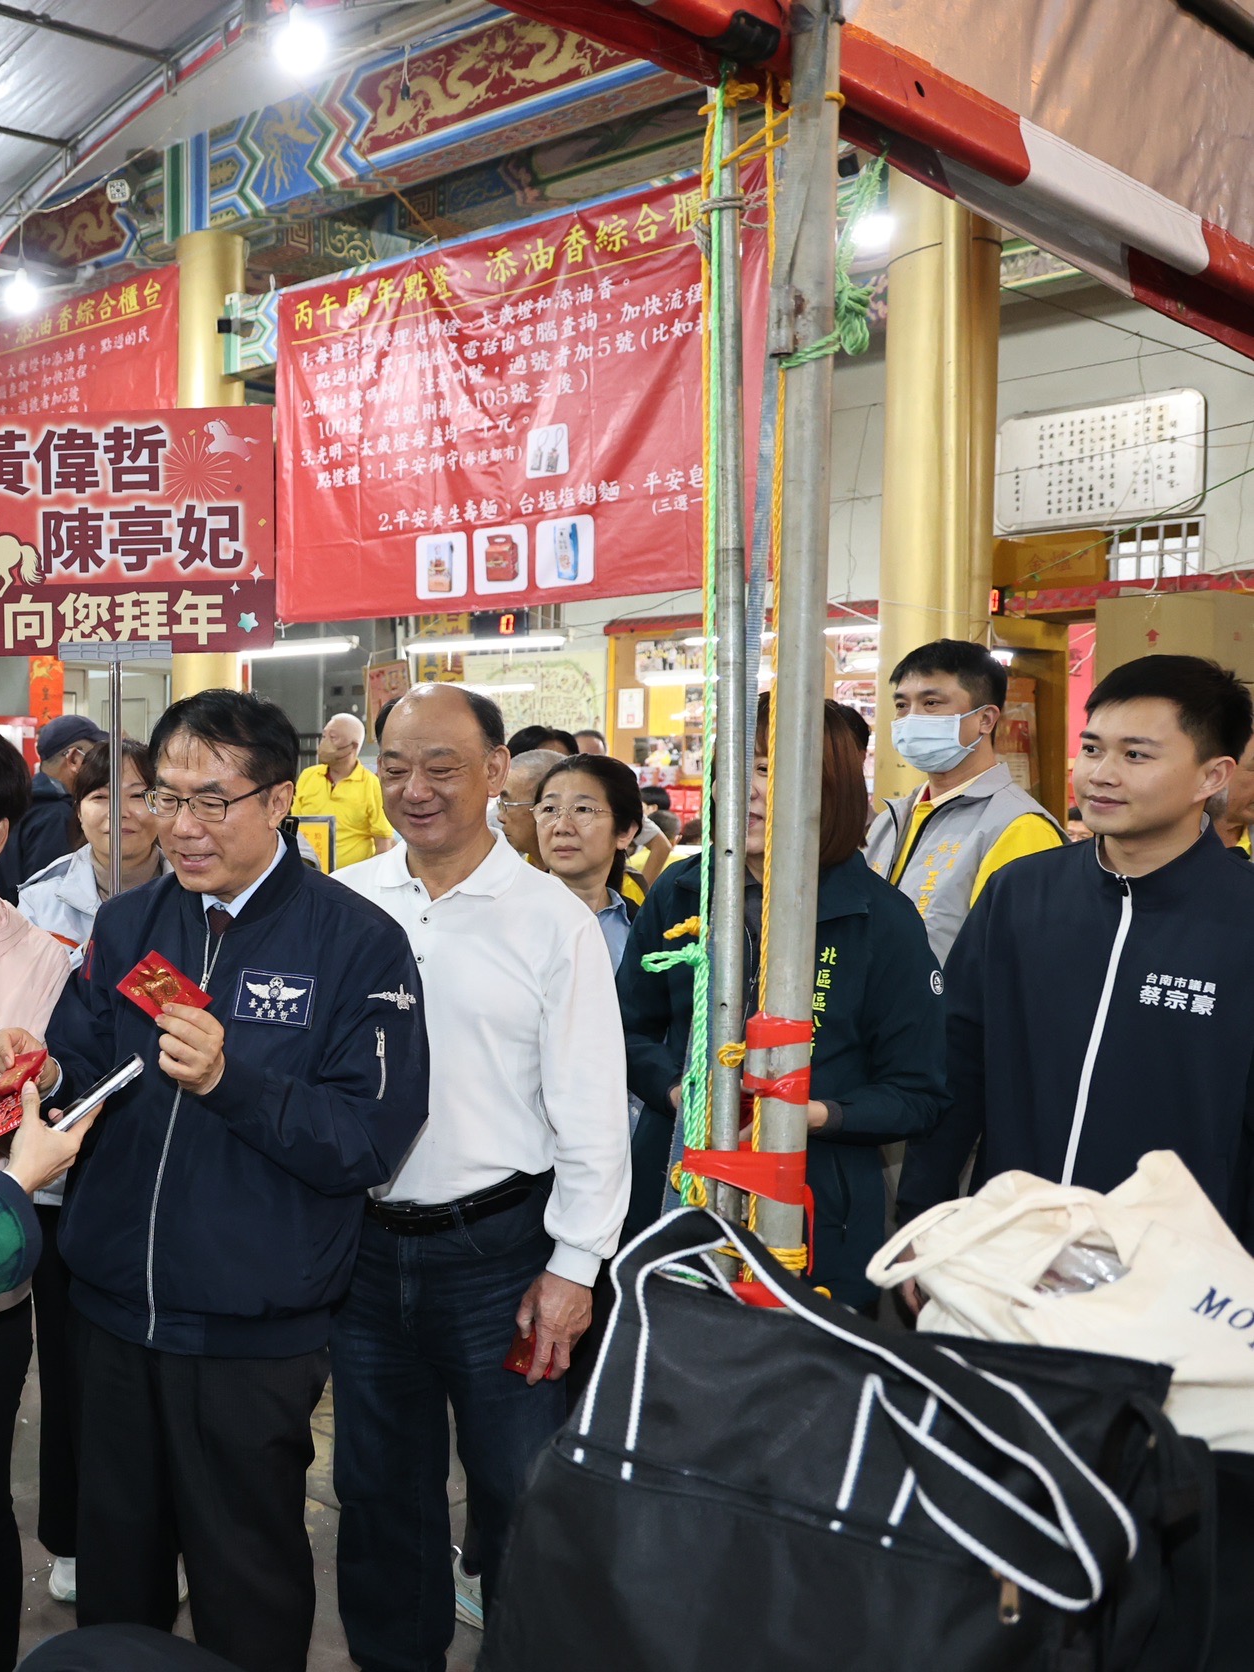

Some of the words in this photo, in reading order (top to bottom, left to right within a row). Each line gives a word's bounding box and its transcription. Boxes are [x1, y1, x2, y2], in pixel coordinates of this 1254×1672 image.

[42, 504, 244, 574] 陳亭妃
[3, 589, 227, 649] 向您拜年
[1139, 984, 1217, 1016] 蔡宗豪
[1146, 972, 1217, 995] 台南市議員
[255, 1007, 290, 1021] 黃偉哲
[1189, 1285, 1254, 1351] MO
